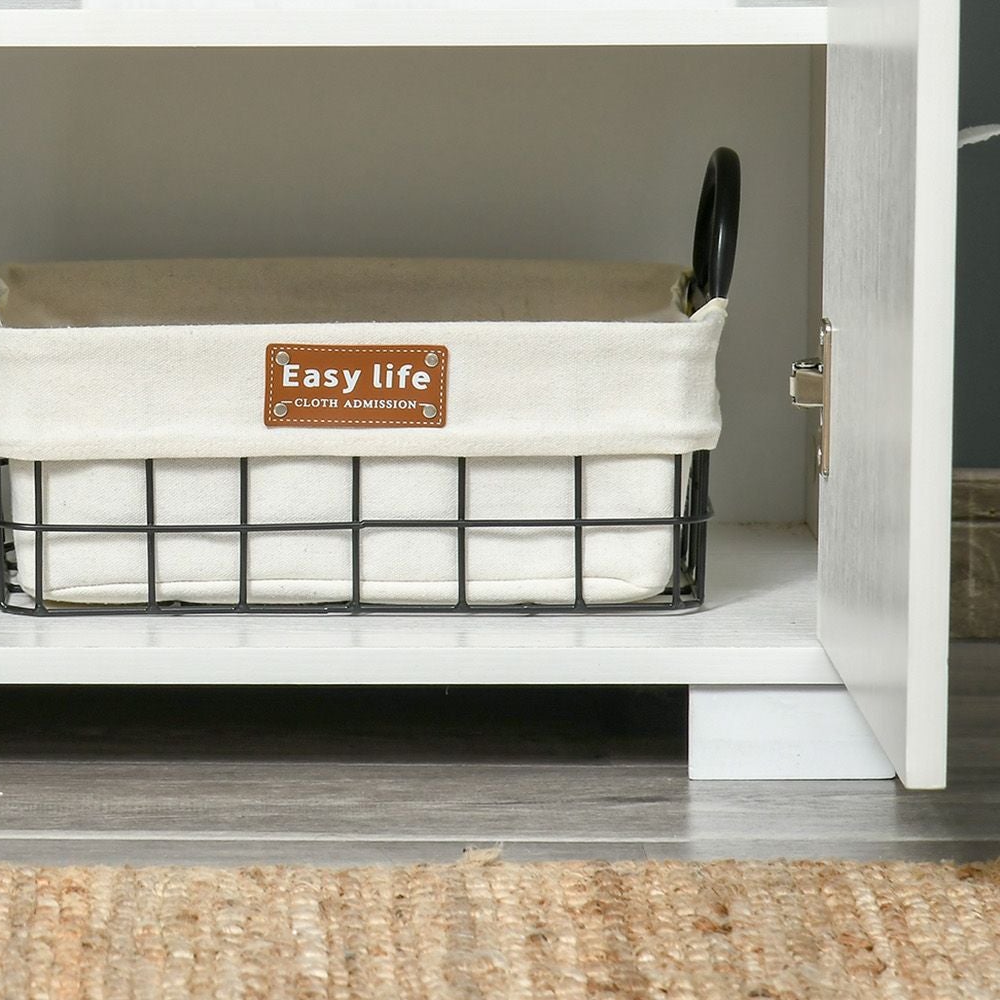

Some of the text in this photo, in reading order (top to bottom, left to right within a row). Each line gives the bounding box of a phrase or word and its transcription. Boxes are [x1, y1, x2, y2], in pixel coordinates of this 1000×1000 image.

[282, 363, 431, 394] Easy life
[294, 398, 417, 409] CLOTH ADMISSION
